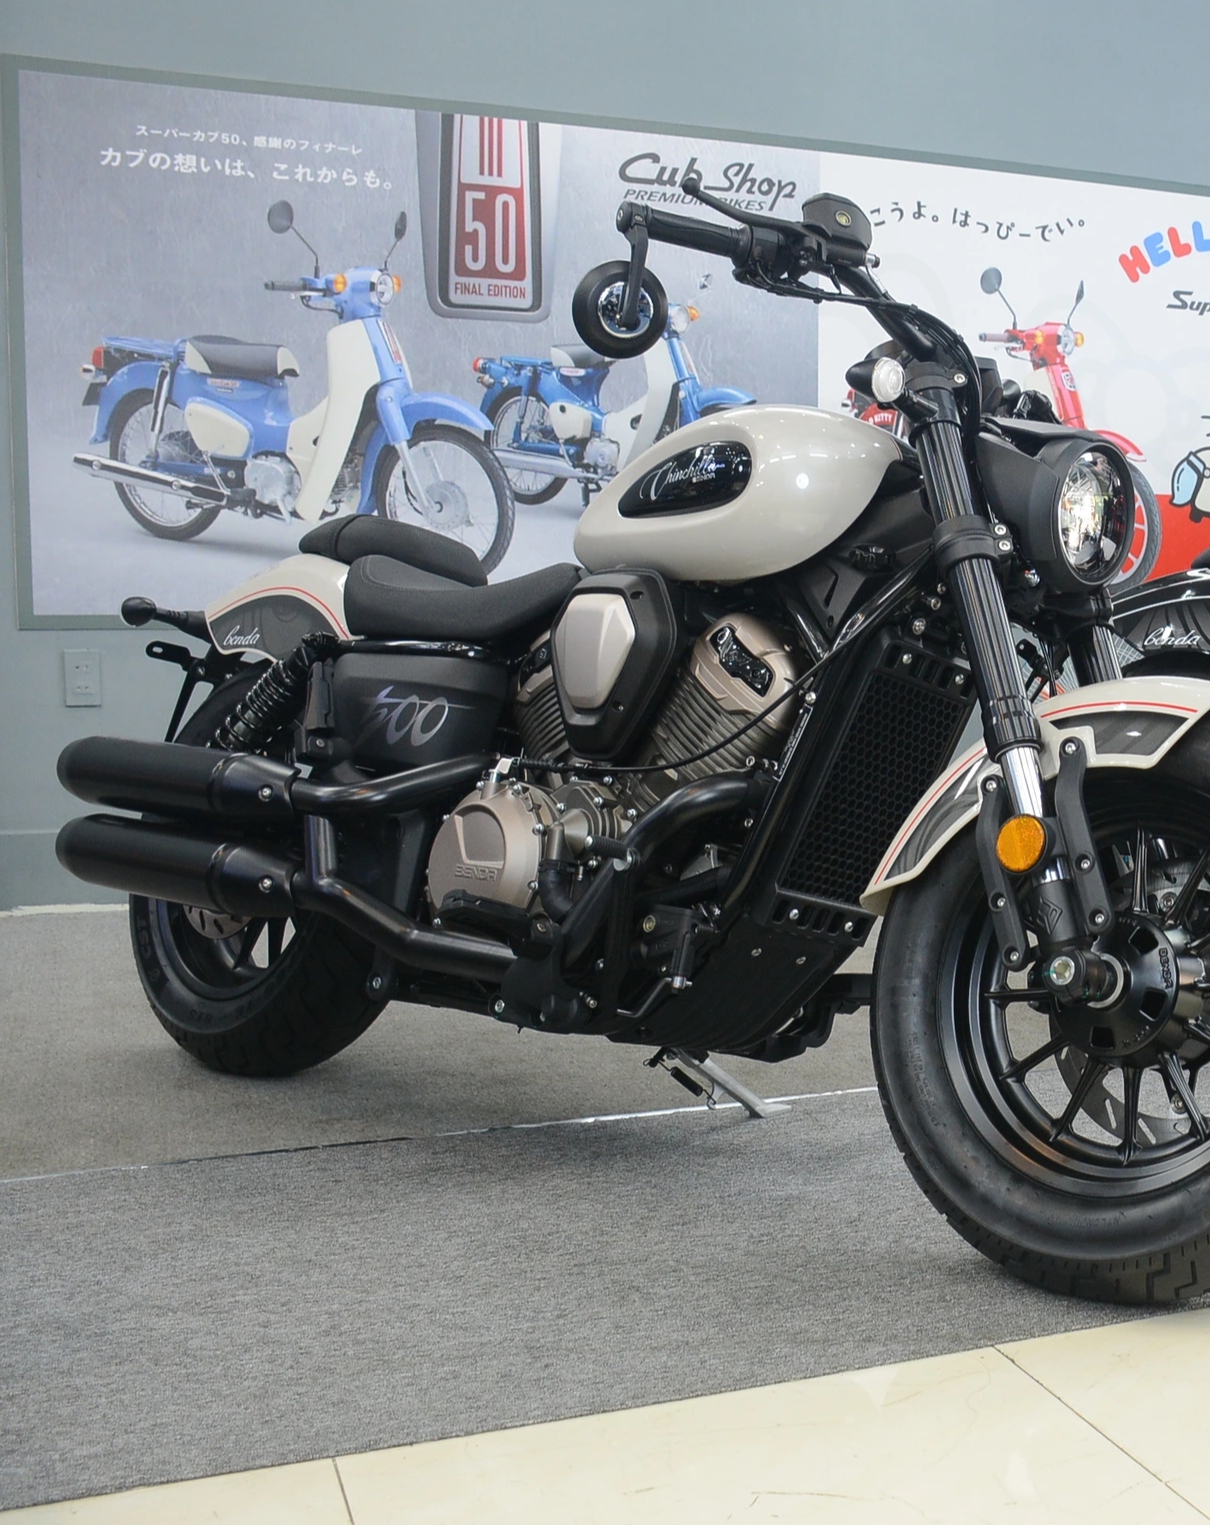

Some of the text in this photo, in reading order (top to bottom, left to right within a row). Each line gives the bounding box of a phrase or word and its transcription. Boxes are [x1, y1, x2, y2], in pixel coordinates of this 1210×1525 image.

[100, 147, 393, 190] カブの想いは、これからも。
[704, 162, 797, 212] Shop
[465, 190, 516, 273] 50
[454, 282, 526, 299] FINAL EDITION
[222, 624, 260, 646] benda
[454, 864, 499, 882] BENDA
